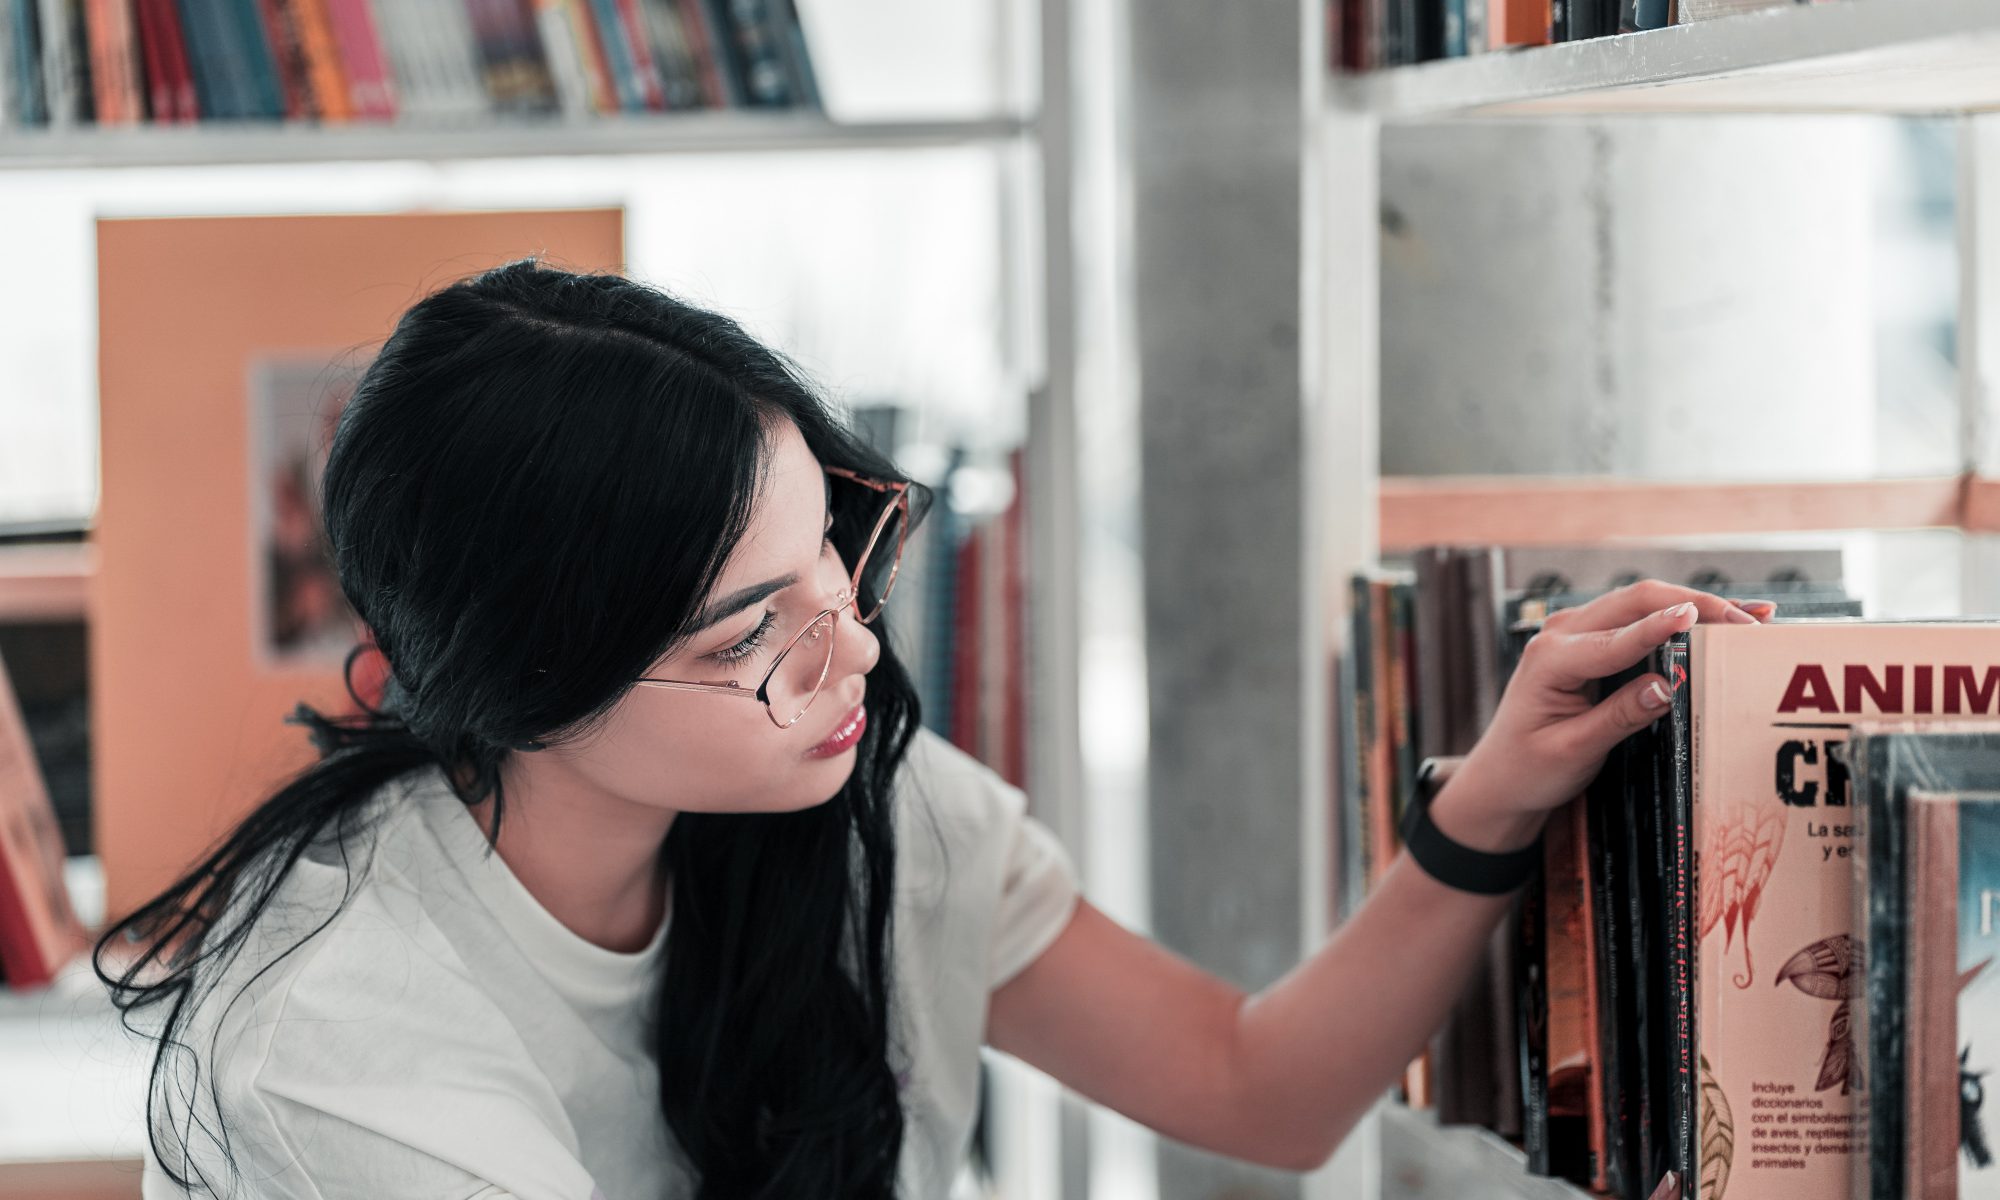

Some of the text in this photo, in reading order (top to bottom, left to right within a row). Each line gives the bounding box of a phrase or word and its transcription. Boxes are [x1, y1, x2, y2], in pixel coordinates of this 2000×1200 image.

[1777, 664, 2000, 714] ANIM
[1808, 821, 1828, 837] La
[1822, 845, 1833, 862] y
[1752, 1082, 1795, 1096] Incluye
[1751, 1098, 1823, 1109] diccionarios
[1751, 1114, 1774, 1124] con
[1777, 1113, 1788, 1124] el
[1751, 1128, 1767, 1139] de
[1770, 1129, 1802, 1140] aves,
[1751, 1143, 1801, 1154] insectos
[1804, 1145, 1811, 1157] y
[1751, 1159, 1806, 1169] animales
